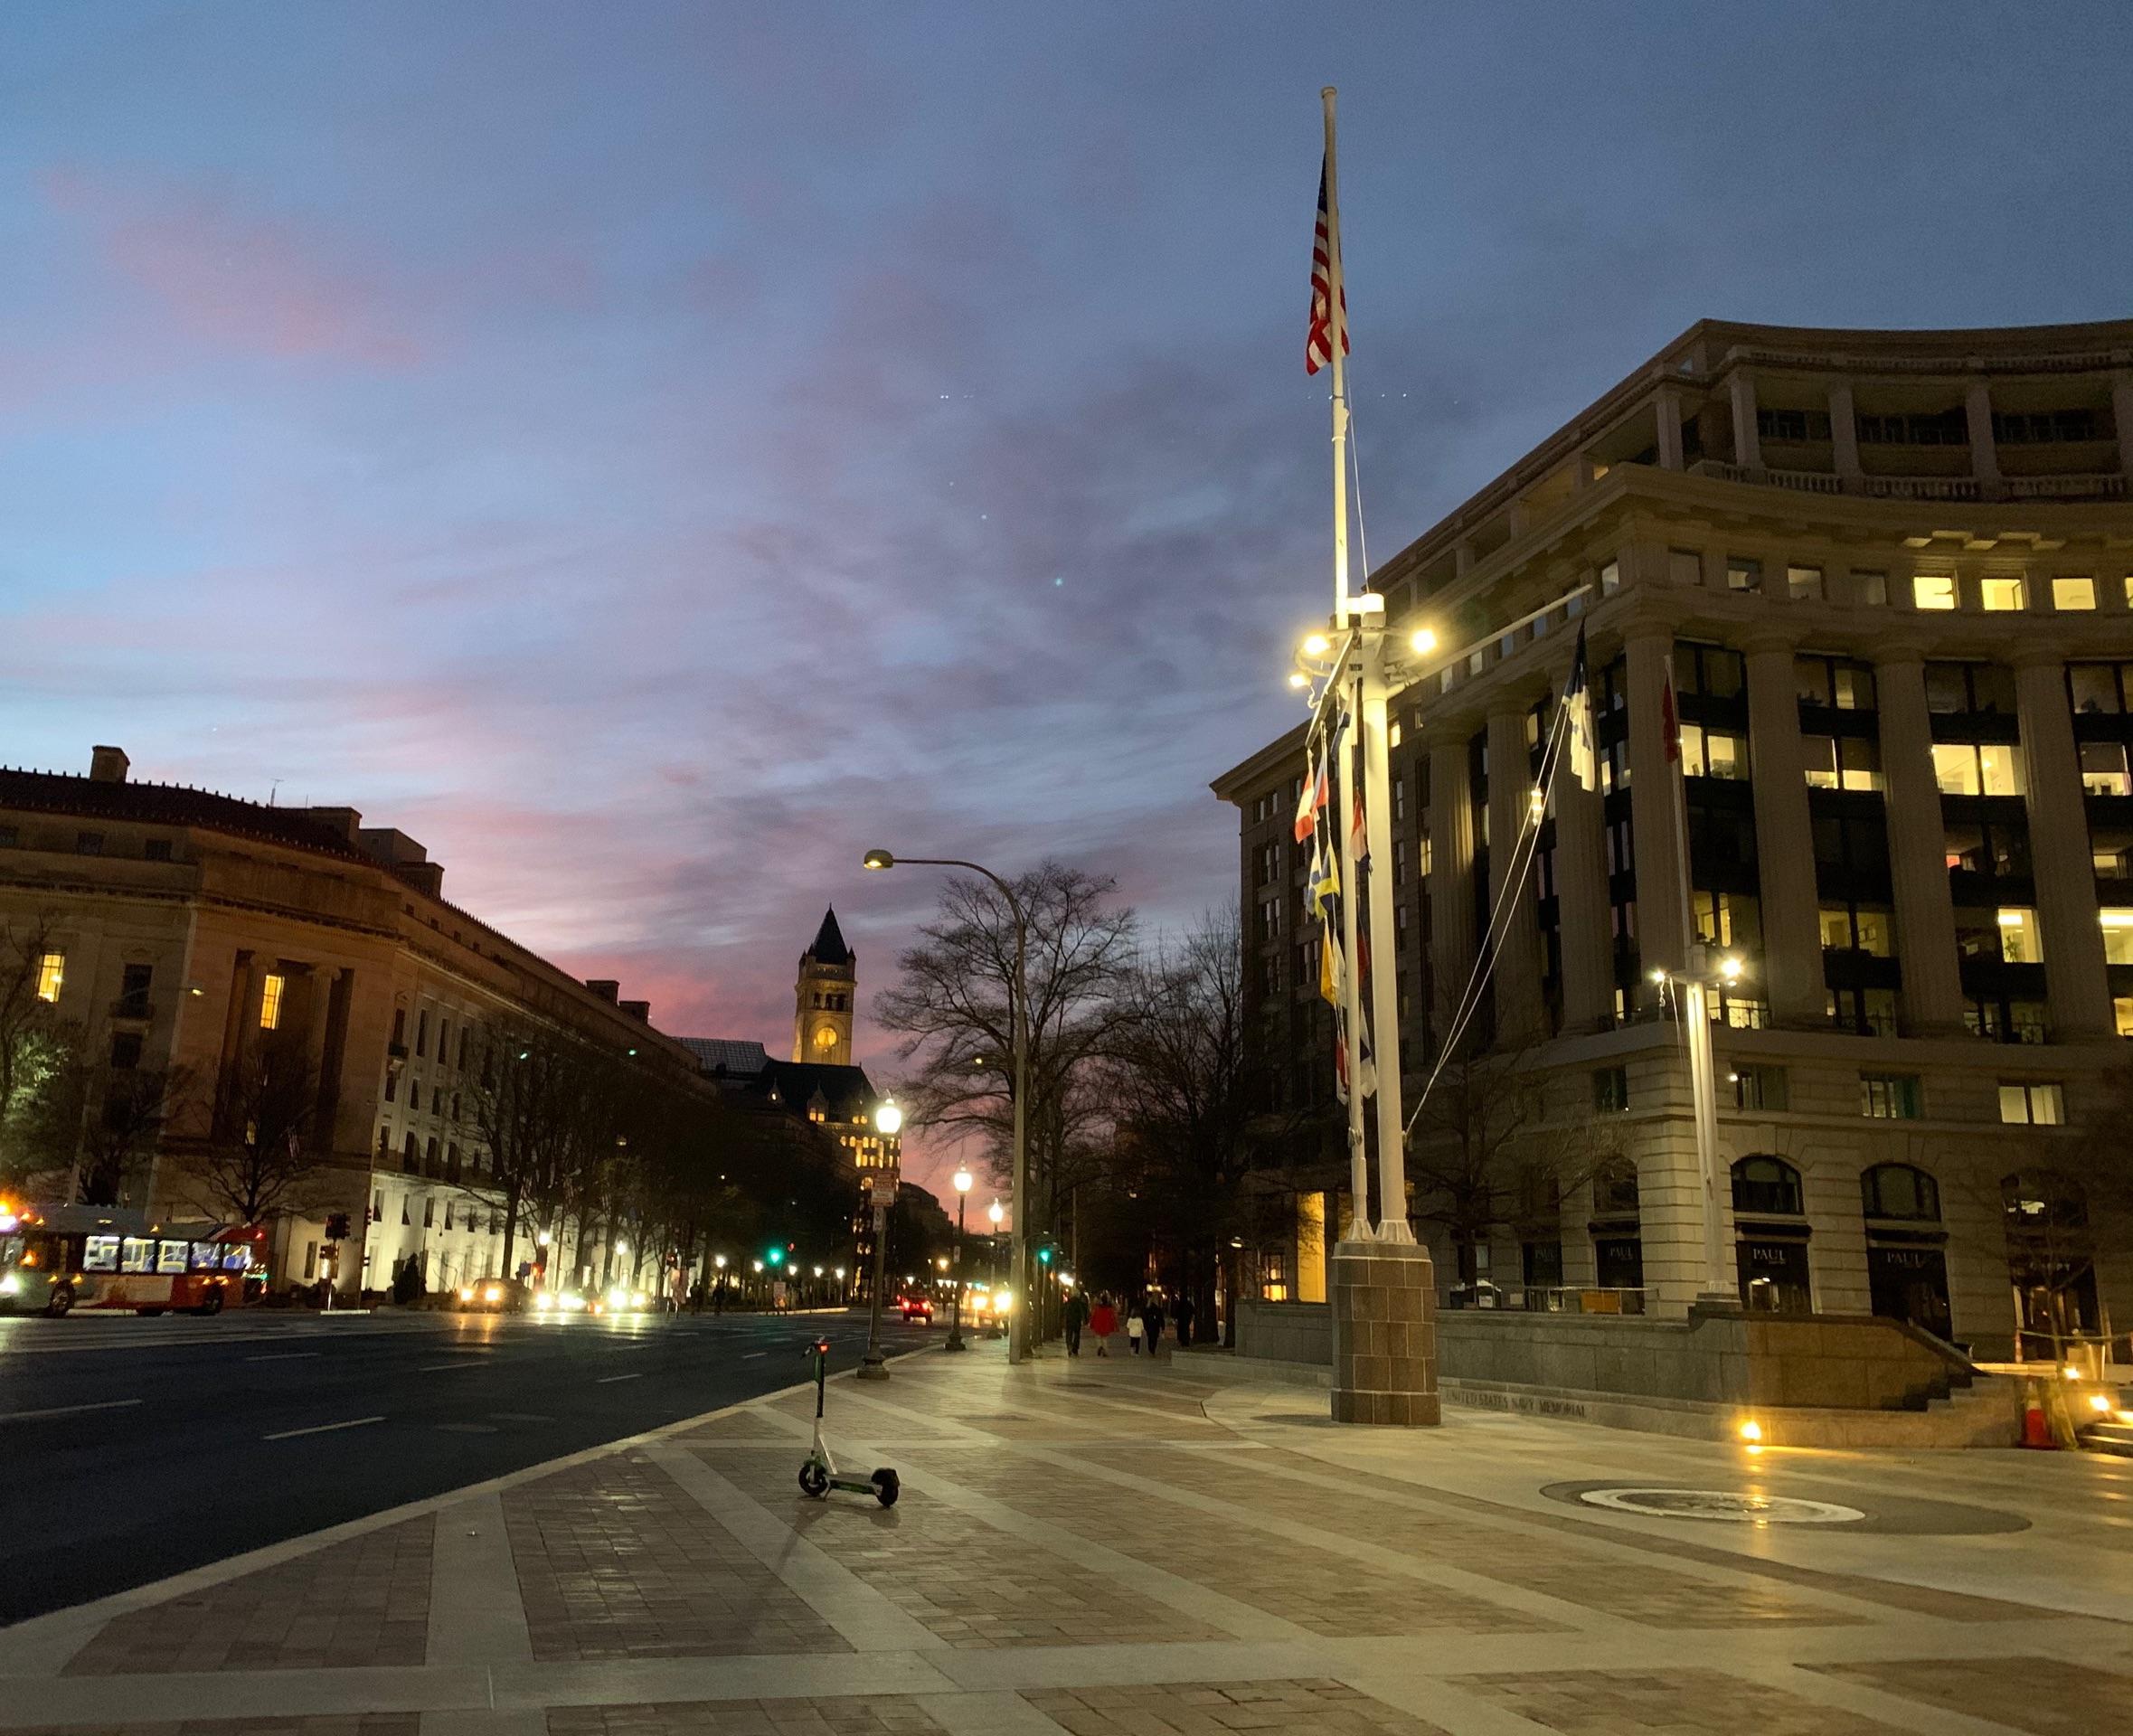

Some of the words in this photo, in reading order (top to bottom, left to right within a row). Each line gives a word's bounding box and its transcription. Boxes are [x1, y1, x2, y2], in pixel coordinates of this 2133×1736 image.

[1752, 1248, 1787, 1261] PAUL
[1887, 1251, 1923, 1266] PAUL
[1479, 1393, 1508, 1409] STATES
[1539, 1401, 1585, 1417] MEMORIAL
